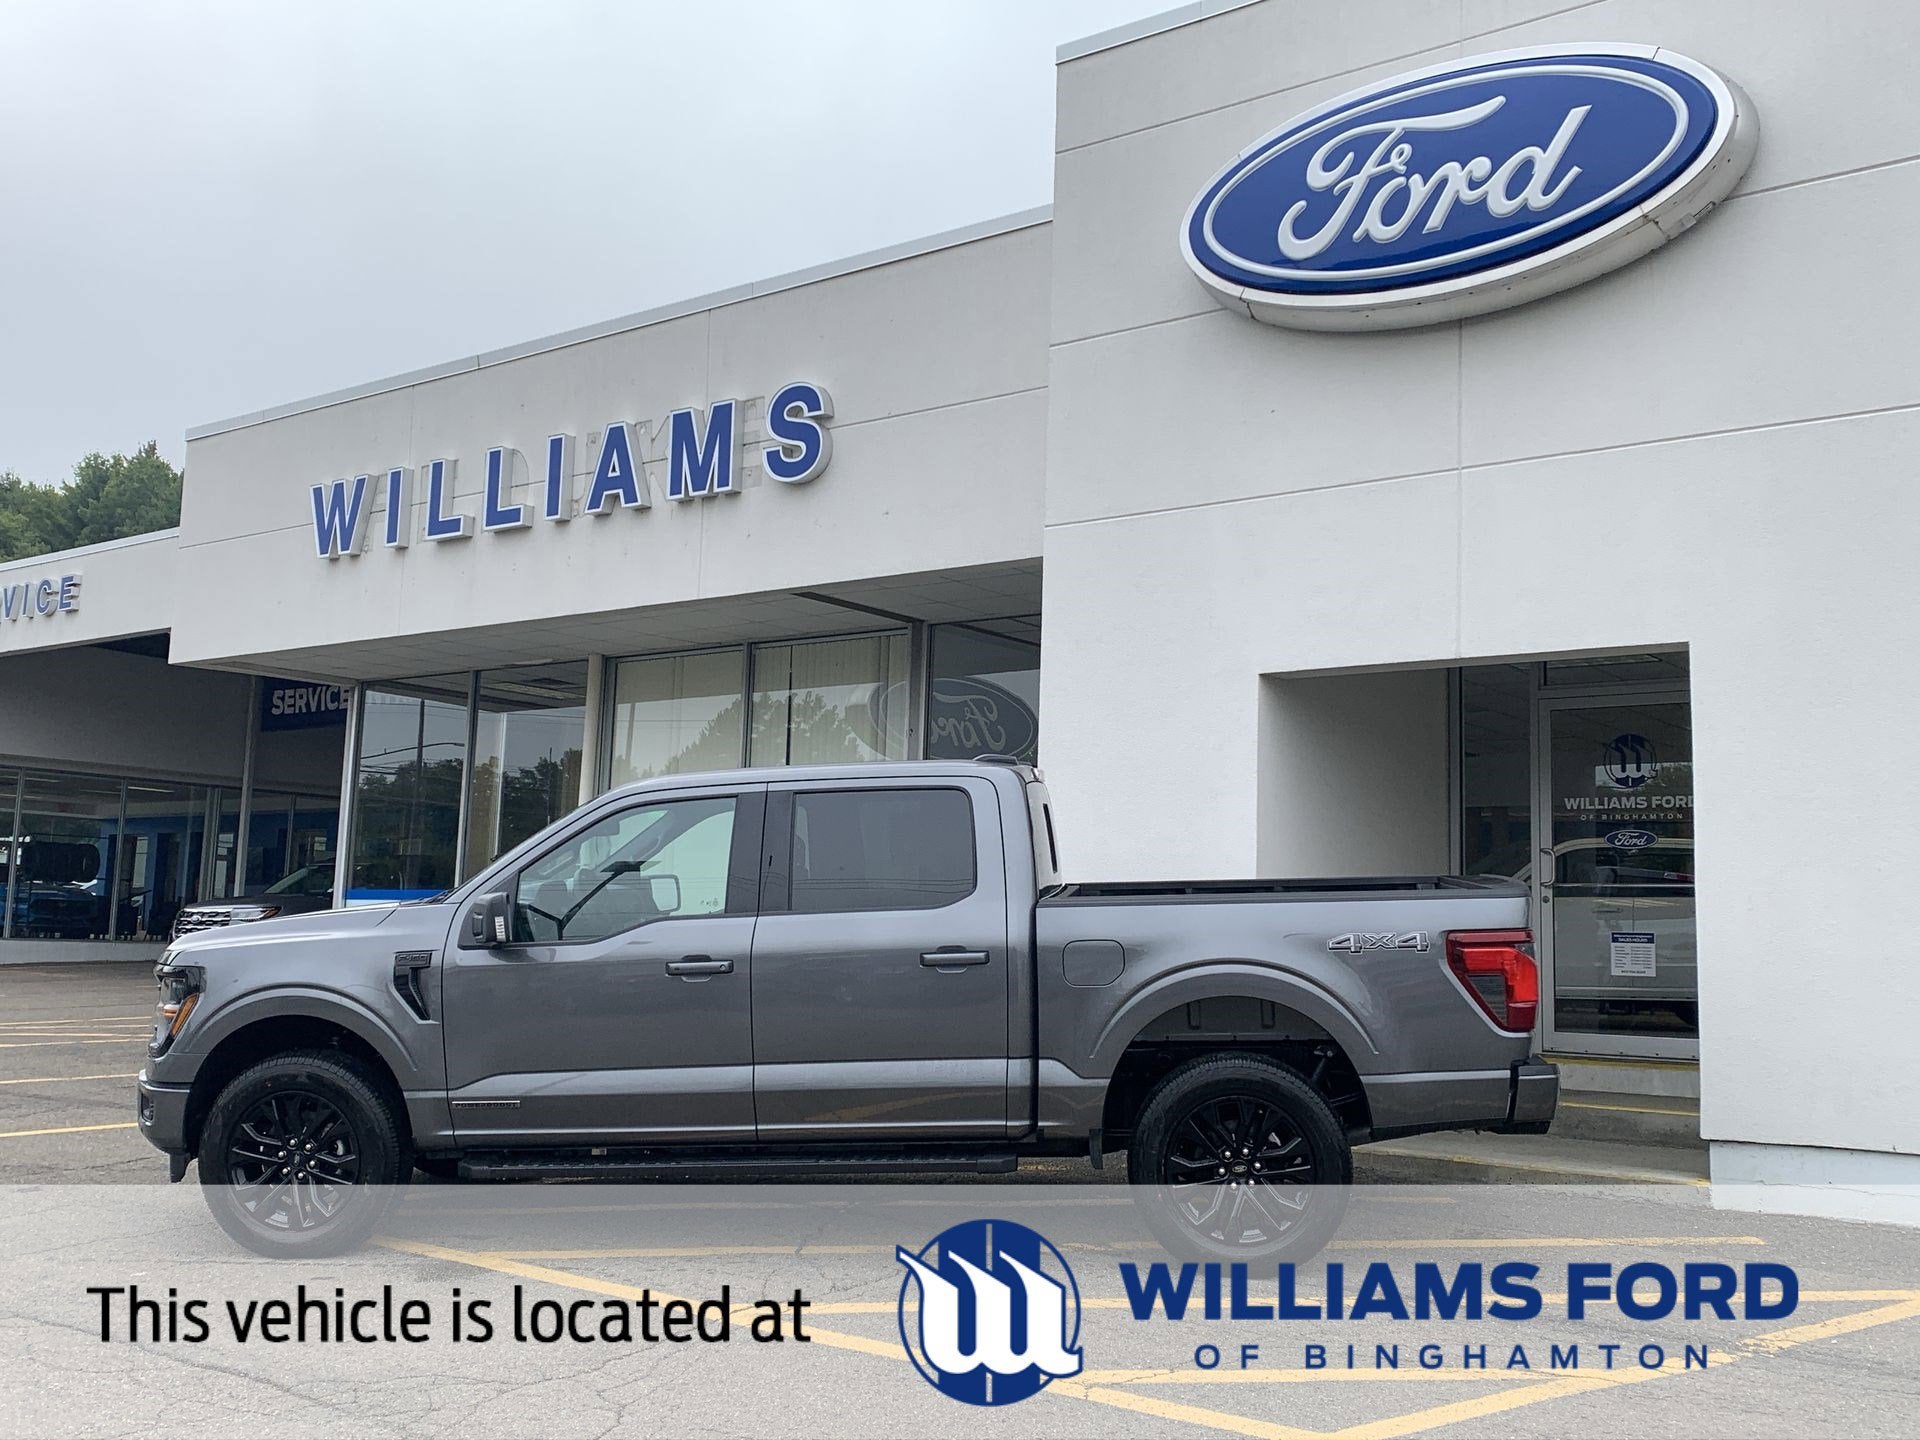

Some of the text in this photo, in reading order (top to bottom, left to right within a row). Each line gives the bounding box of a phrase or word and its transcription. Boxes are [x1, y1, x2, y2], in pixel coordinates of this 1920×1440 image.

[1278, 95, 1593, 260] Ford
[309, 381, 834, 560] WILLIAMS
[0, 573, 82, 621] VICE
[271, 685, 349, 715] SERVICE
[1564, 795, 1648, 810] WILLIAMS
[1601, 813, 1683, 821] BINGHAMTON
[1614, 831, 1648, 846] Ford
